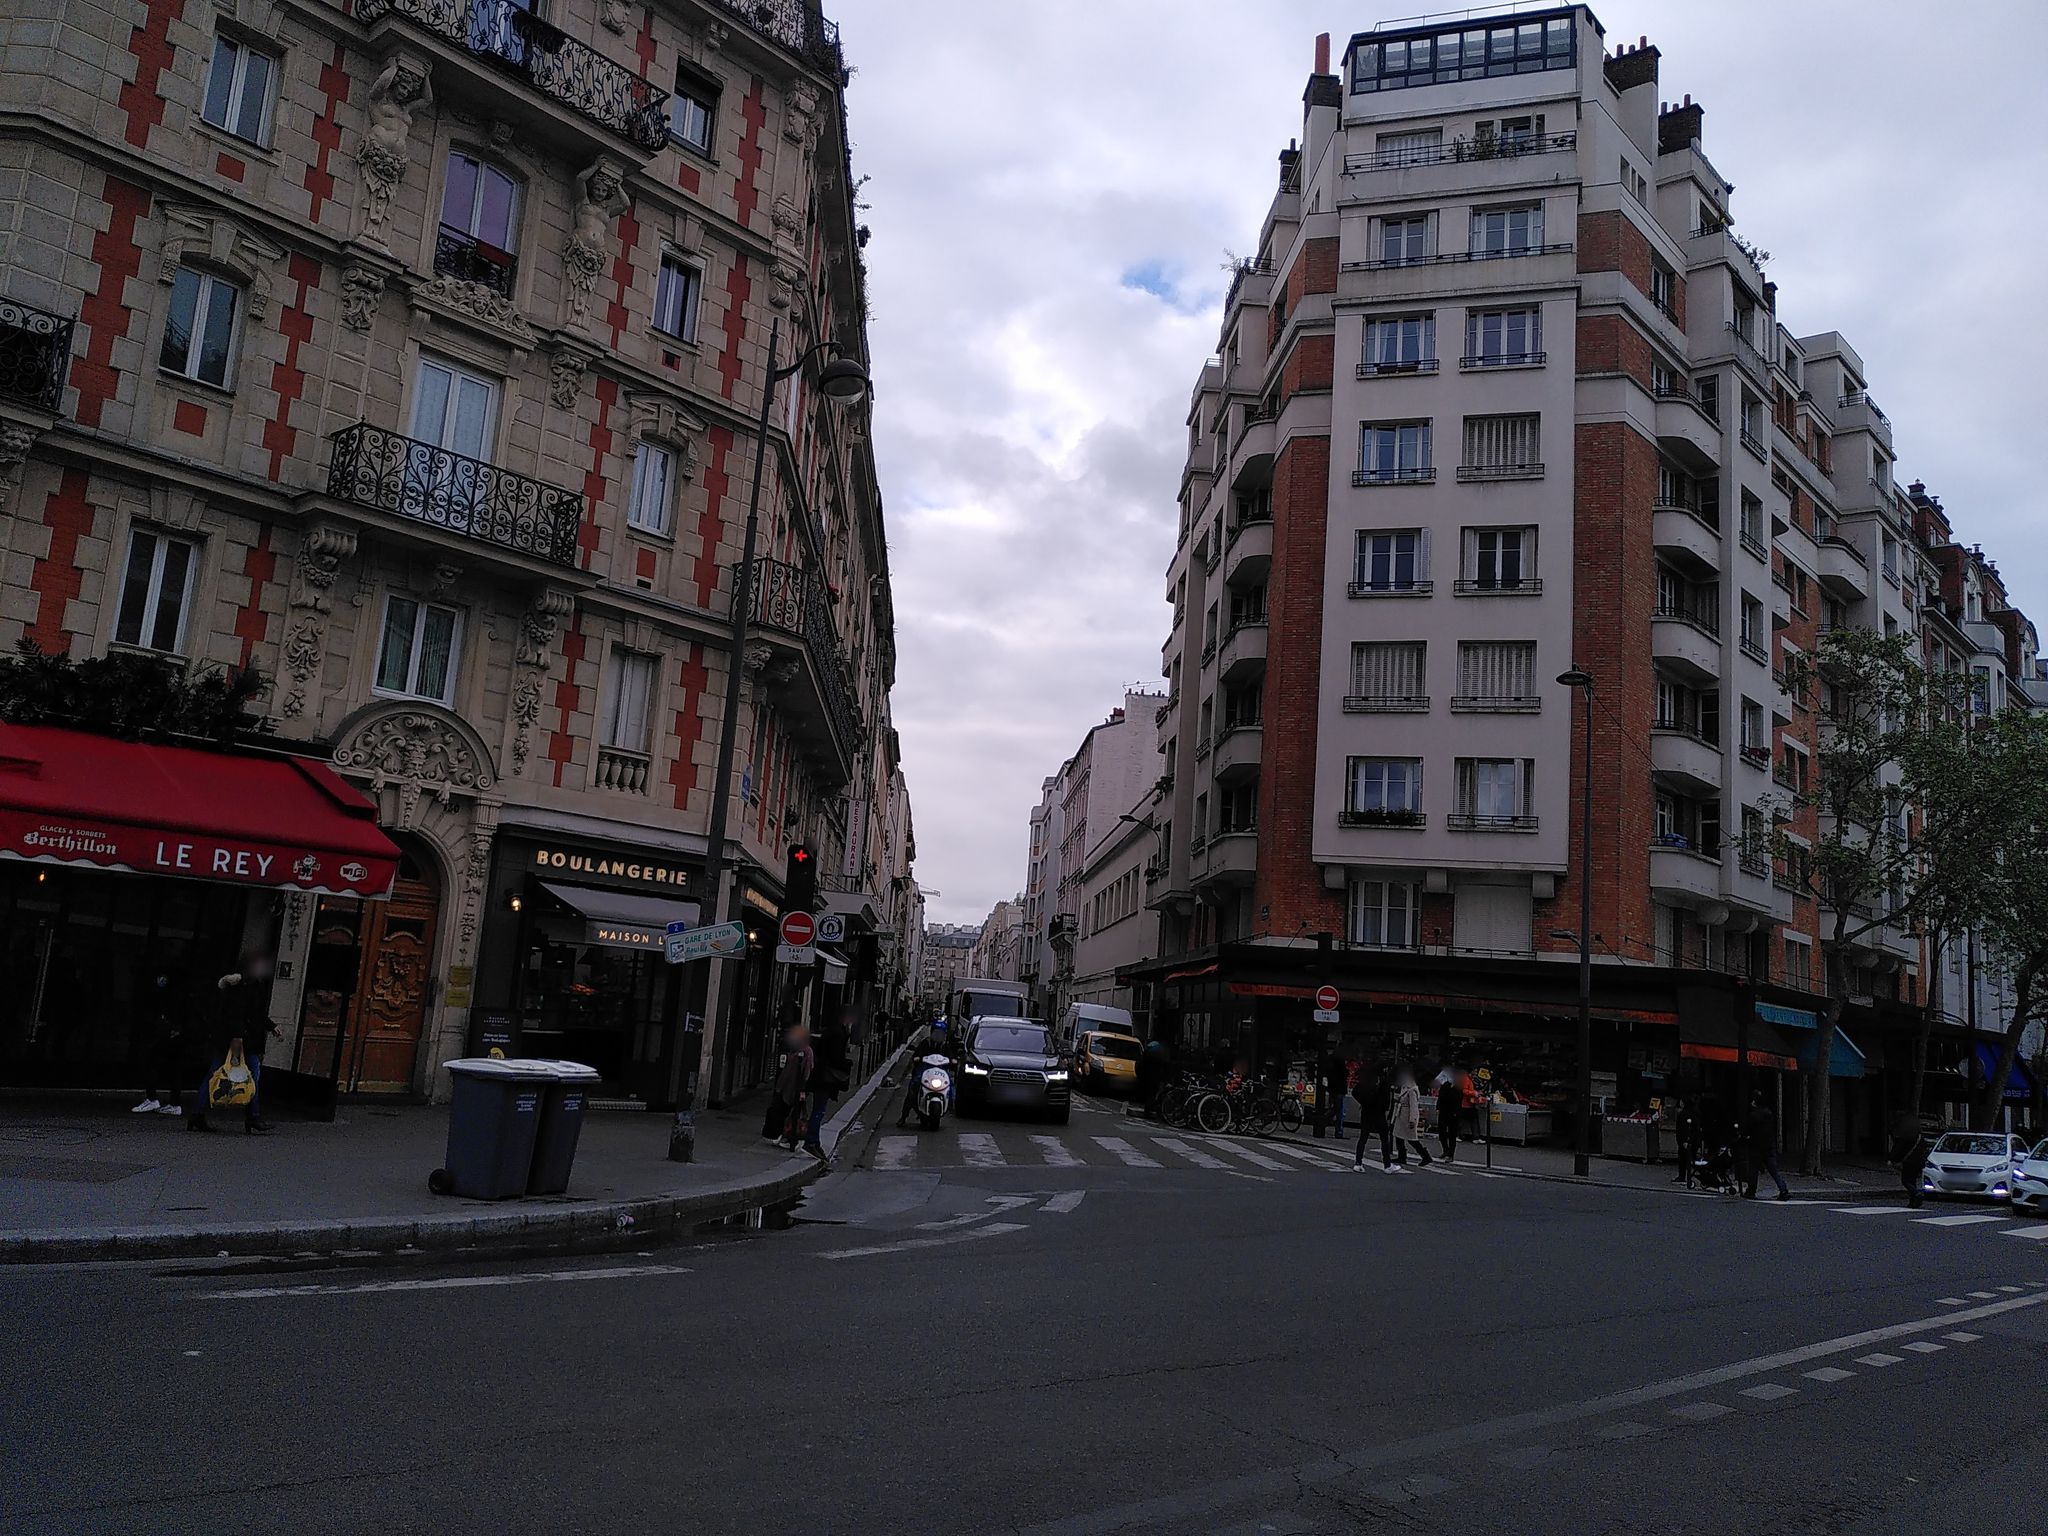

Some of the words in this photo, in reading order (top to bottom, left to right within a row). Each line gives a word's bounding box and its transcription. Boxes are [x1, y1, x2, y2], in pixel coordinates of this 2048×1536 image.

[23, 831, 117, 855] Berthillon
[40, 825, 67, 834] GLACES
[76, 829, 107, 839] SORBETS
[849, 801, 860, 874] RESTAURANT
[156, 841, 194, 868] LE
[212, 848, 274, 877] REY
[536, 850, 688, 886] BOULANGERIE
[599, 930, 649, 943] MAISON
[684, 934, 702, 944] GARE
[704, 932, 713, 941] DE
[715, 928, 731, 939] LYON
